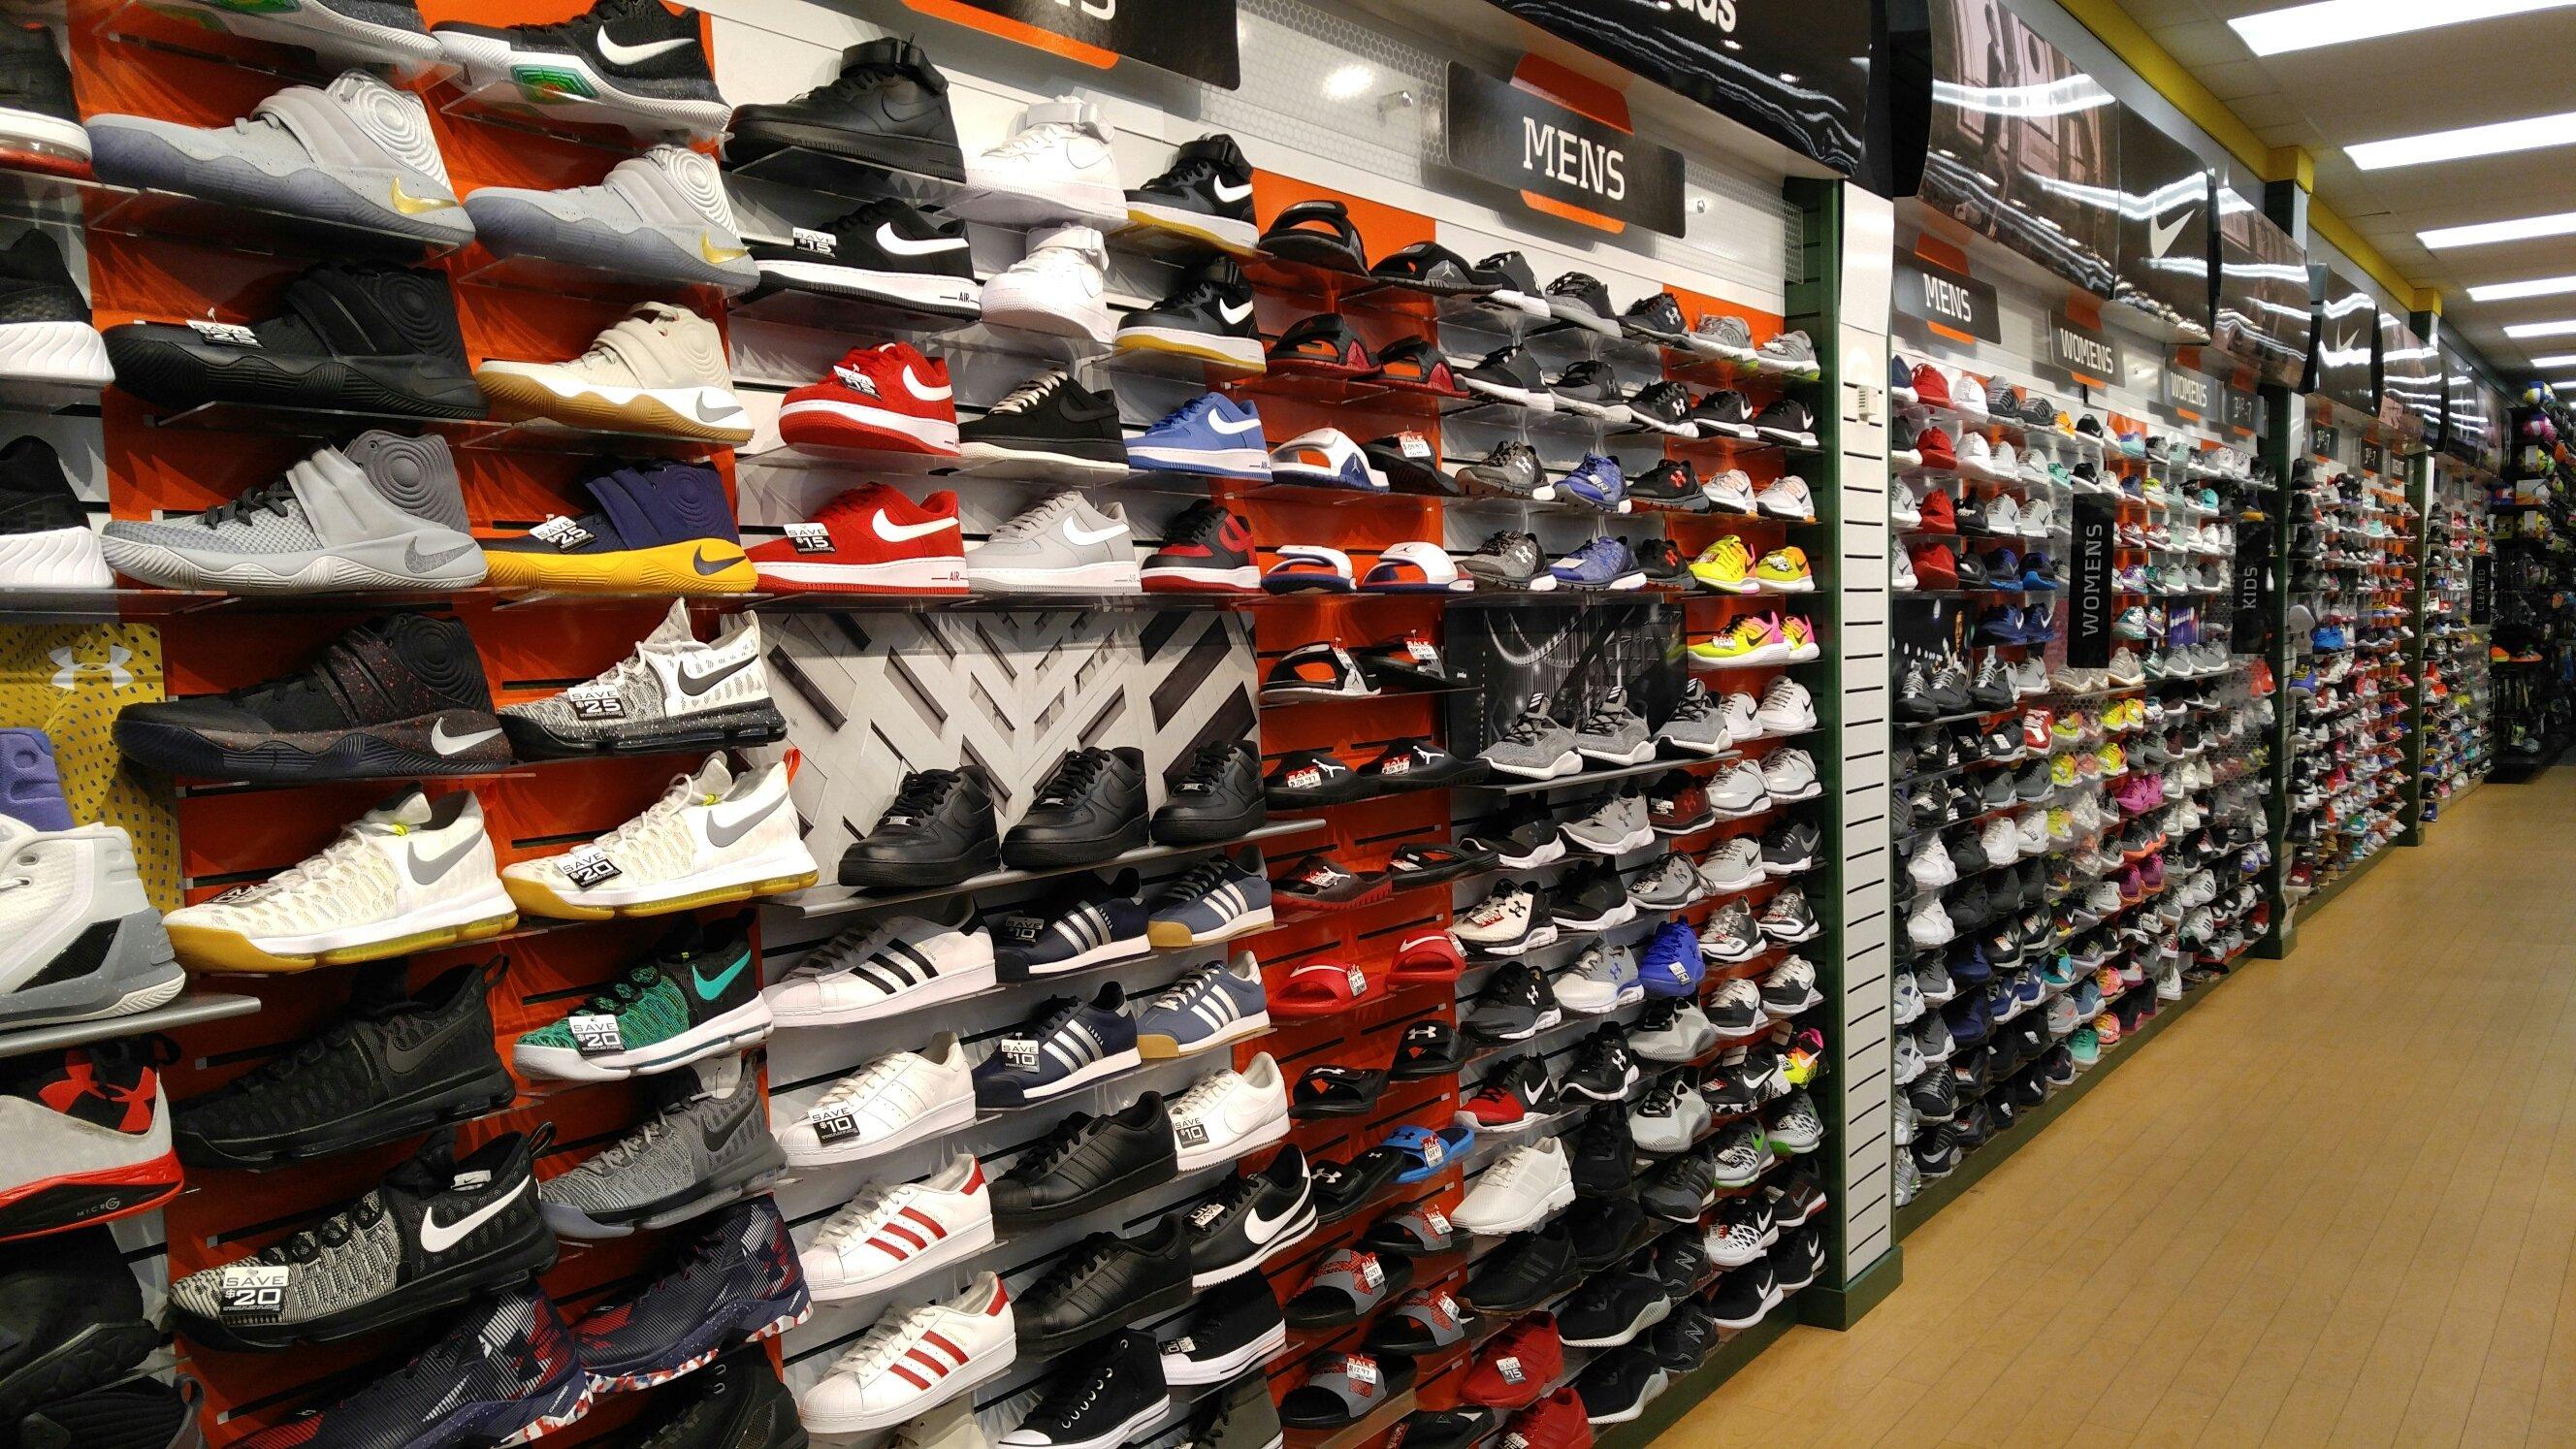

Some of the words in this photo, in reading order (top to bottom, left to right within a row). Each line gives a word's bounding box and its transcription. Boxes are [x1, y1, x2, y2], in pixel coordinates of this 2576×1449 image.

[1522, 115, 1625, 201] MENS
[795, 233, 834, 242] SAVE
[959, 292, 969, 302] AIR
[1923, 274, 1972, 322] MENS
[2060, 328, 2113, 374] WOMENS
[2171, 372, 2207, 407] WOMENS
[537, 521, 572, 538] SAVE
[950, 571, 960, 582] AIR
[2082, 523, 2102, 637] WOMENS
[2242, 566, 2258, 610] KIDS
[2476, 568, 2486, 612] CLEATED
[572, 690, 617, 700] SAVE
[563, 853, 605, 873] SAVE
[1008, 920, 1043, 931] SAVE
[1098, 908, 1113, 930] SAMOA
[573, 1023, 619, 1032] SAVE
[1087, 1025, 1104, 1046] SAMOA
[577, 1033, 620, 1047] $20
[1003, 1045, 1037, 1053] SAVE
[813, 1108, 850, 1122] SAVE
[820, 1116, 852, 1133] $10
[1175, 1118, 1202, 1130] SAVE
[1180, 1125, 1204, 1141] $10
[1362, 1257, 1377, 1271] SALE
[225, 1276, 286, 1287] SAVE
[226, 1289, 281, 1306] $20
[1348, 1357, 1375, 1369] SALE
